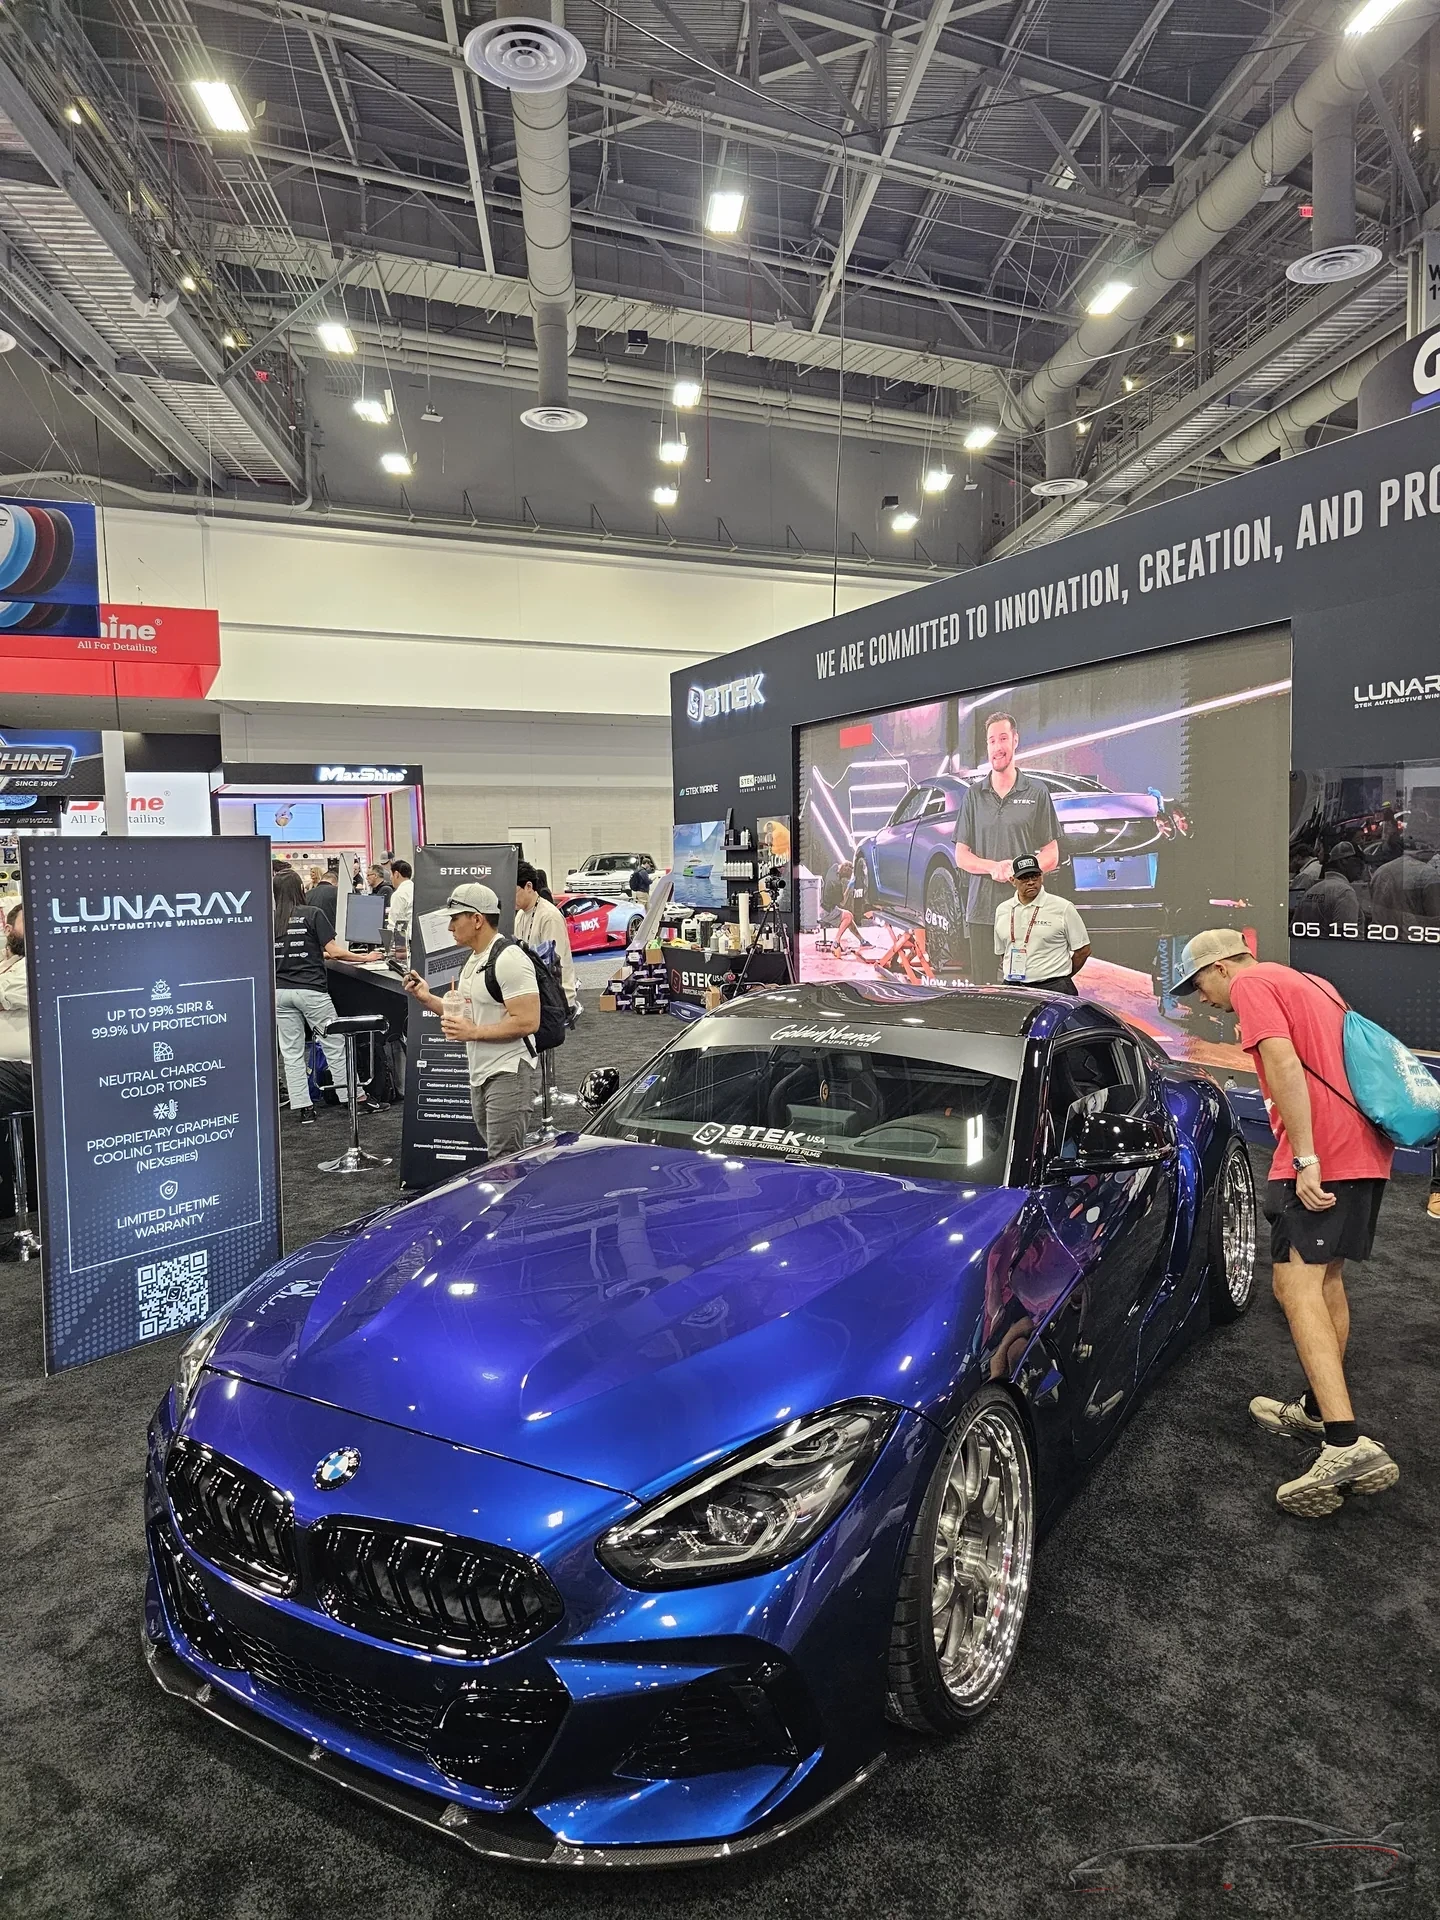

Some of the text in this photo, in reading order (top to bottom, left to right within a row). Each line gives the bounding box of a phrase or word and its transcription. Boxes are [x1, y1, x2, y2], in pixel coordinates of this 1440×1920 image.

[816, 649, 835, 680] WE
[840, 640, 864, 675] ARE
[869, 613, 960, 666] COMMITTED
[965, 604, 988, 641] TO
[995, 563, 1129, 634] INNOVATION,
[1139, 515, 1283, 594] CREATION,
[1296, 489, 1363, 550] AND
[77, 641, 158, 654] All For Detailing
[704, 673, 765, 717] STEK
[1354, 701, 1373, 709] STEK
[1374, 696, 1422, 706] AUTOMOTIVE
[320, 766, 405, 782] MaxShine
[70, 815, 87, 824] All
[90, 815, 105, 824] Fo
[440, 866, 492, 876] STEK ONE
[52, 890, 251, 923] LUNARAY
[53, 924, 87, 934] STEK
[91, 920, 172, 932] AUTOMOTIVE
[176, 918, 223, 927] WINDOW
[1292, 922, 1440, 943] 05 15 20 35
[682, 971, 712, 988] STEK
[107, 1000, 214, 1022] UP TO 99% SIRR &
[91, 1013, 227, 1039] 99.9% UV PROTECTION
[99, 1059, 225, 1088] NEUTRAL CHARCOAL
[121, 1076, 207, 1099] COLOR TONES
[87, 1113, 239, 1152] PROPRIETARY GRAPHENE
[726, 1124, 826, 1147] STEK USA
[94, 1128, 235, 1165] COOLING TECHNOLOGY
[720, 1139, 821, 1158] PROTECTIVE AUTOMOTIVE FILMS
[117, 1194, 220, 1229] LIMITED LIFETIME
[135, 1213, 204, 1239] WARRANTY
